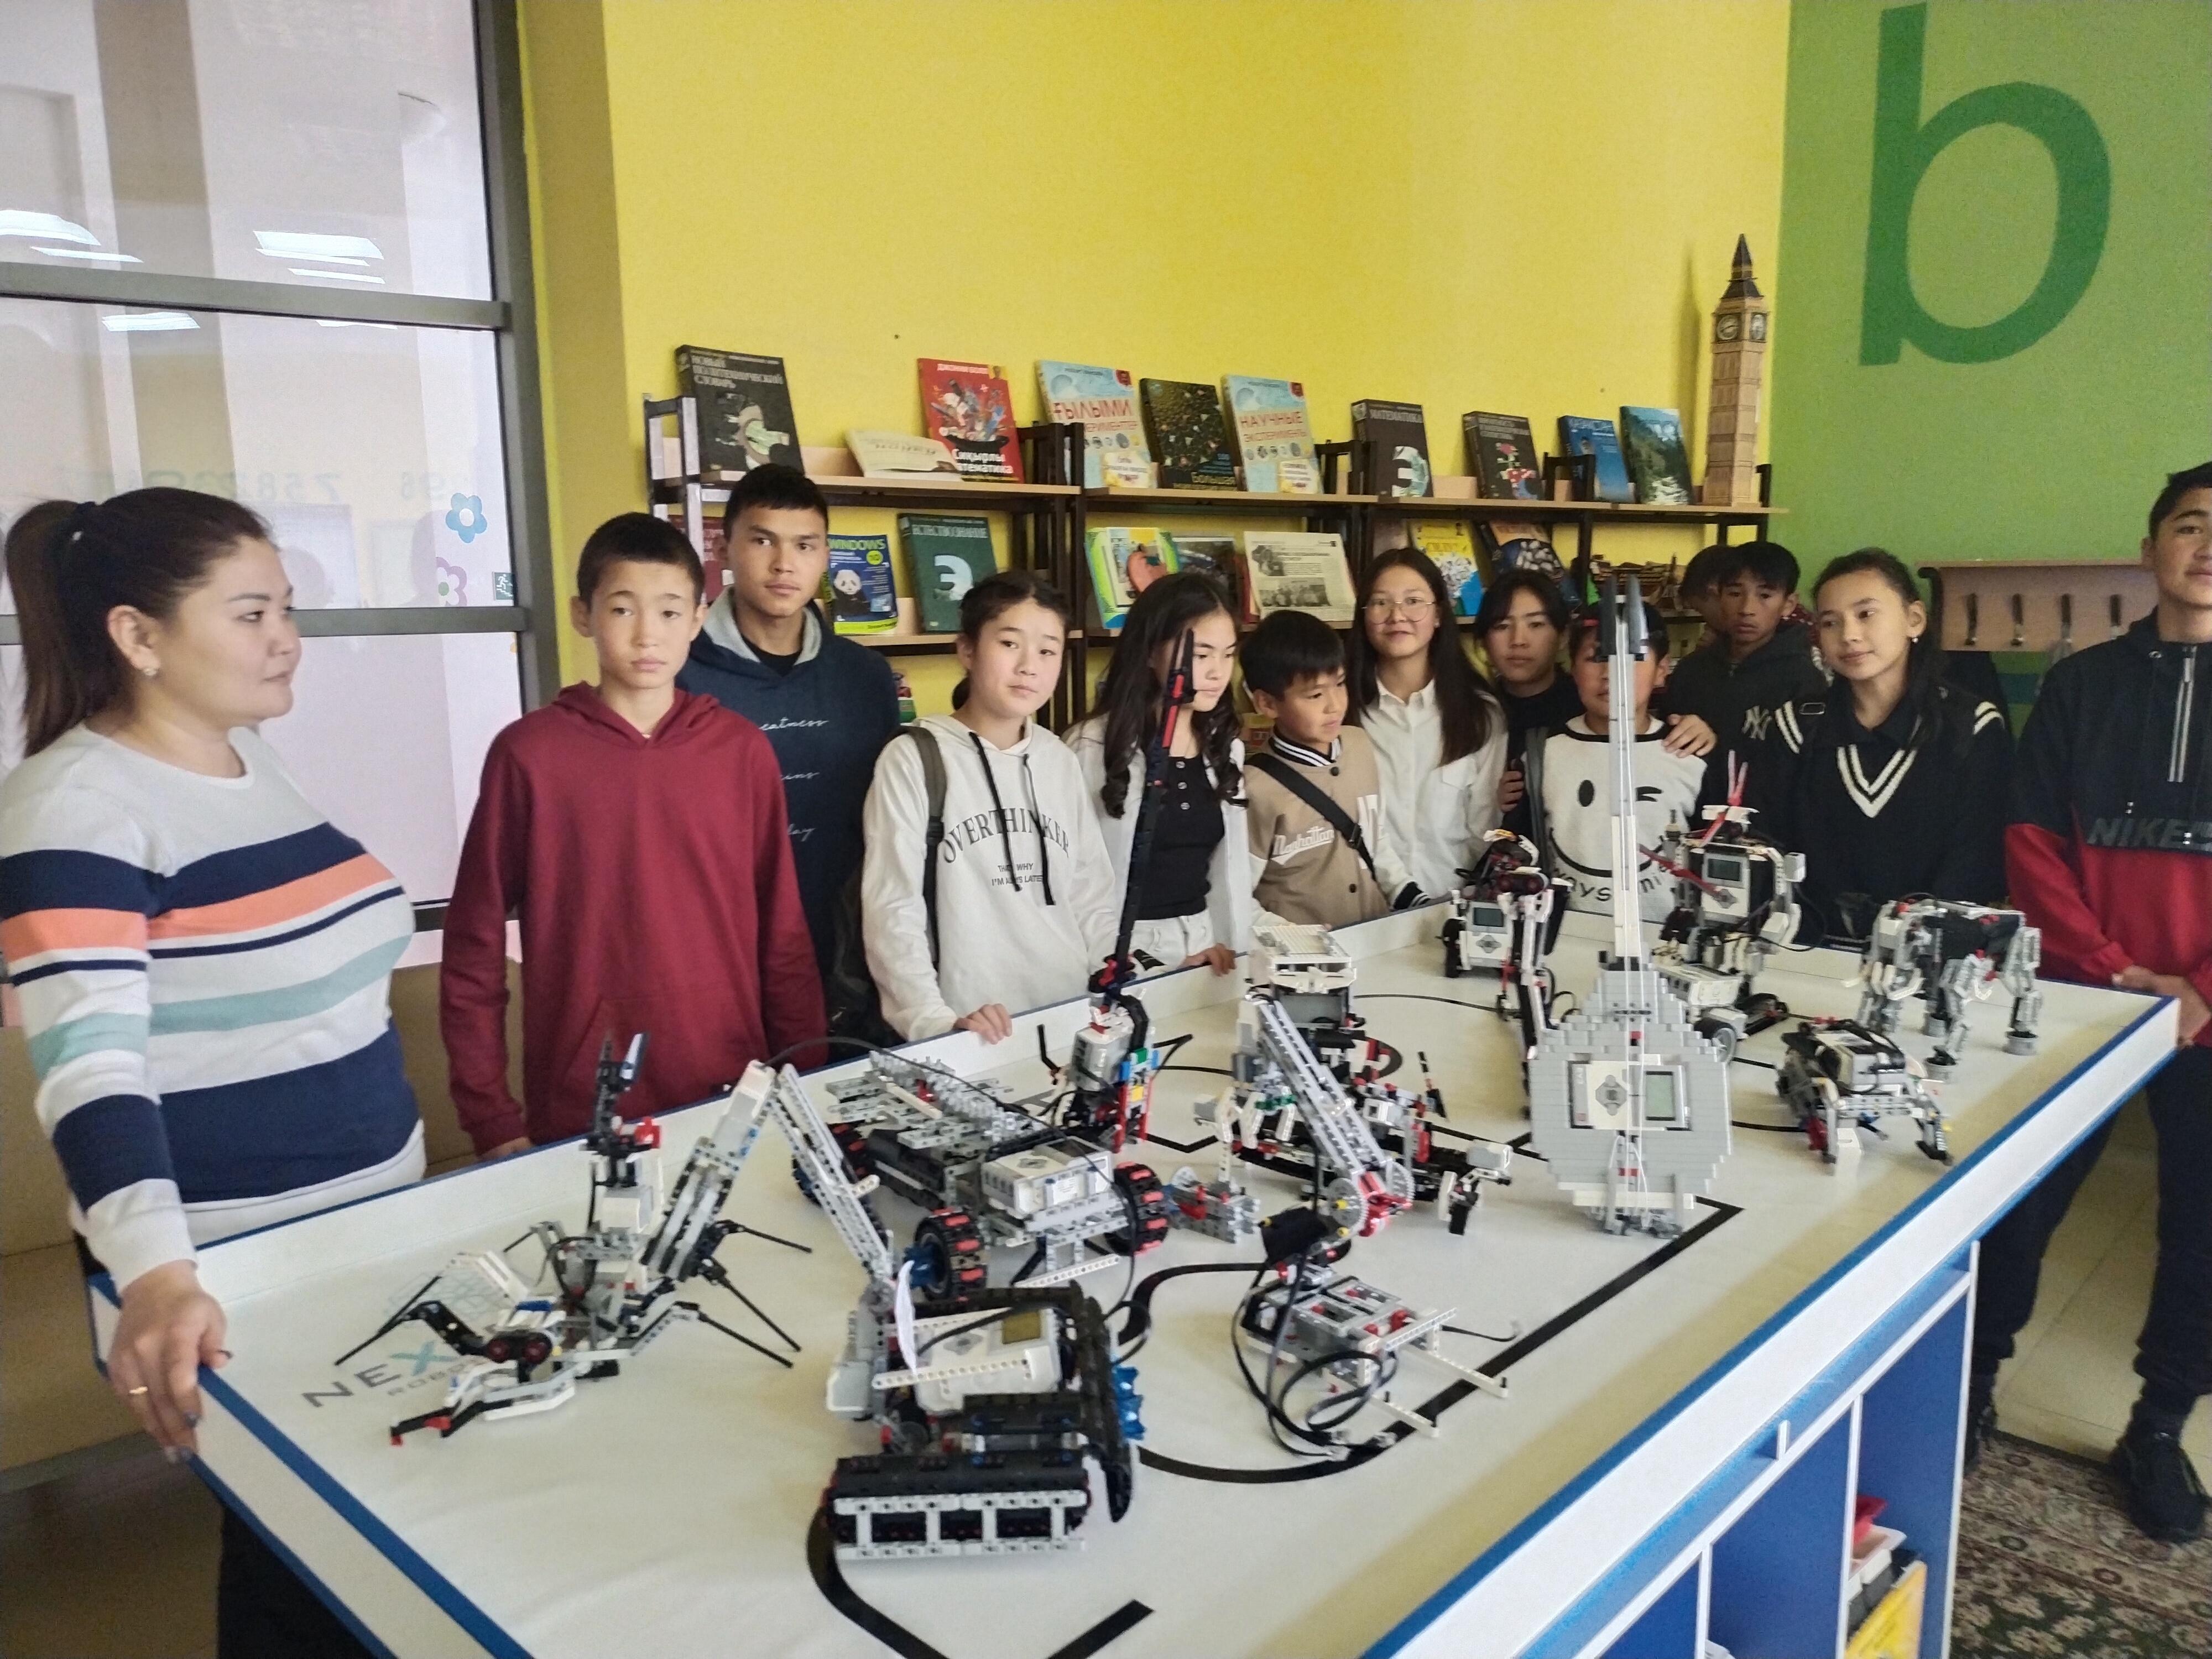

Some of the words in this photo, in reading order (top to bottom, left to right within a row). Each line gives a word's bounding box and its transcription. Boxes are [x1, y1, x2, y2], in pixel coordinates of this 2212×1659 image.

[1859, 2, 2112, 366] b
[1240, 411, 1303, 428] НАУЧНЫЕ
[1016, 863, 1034, 871] WHY
